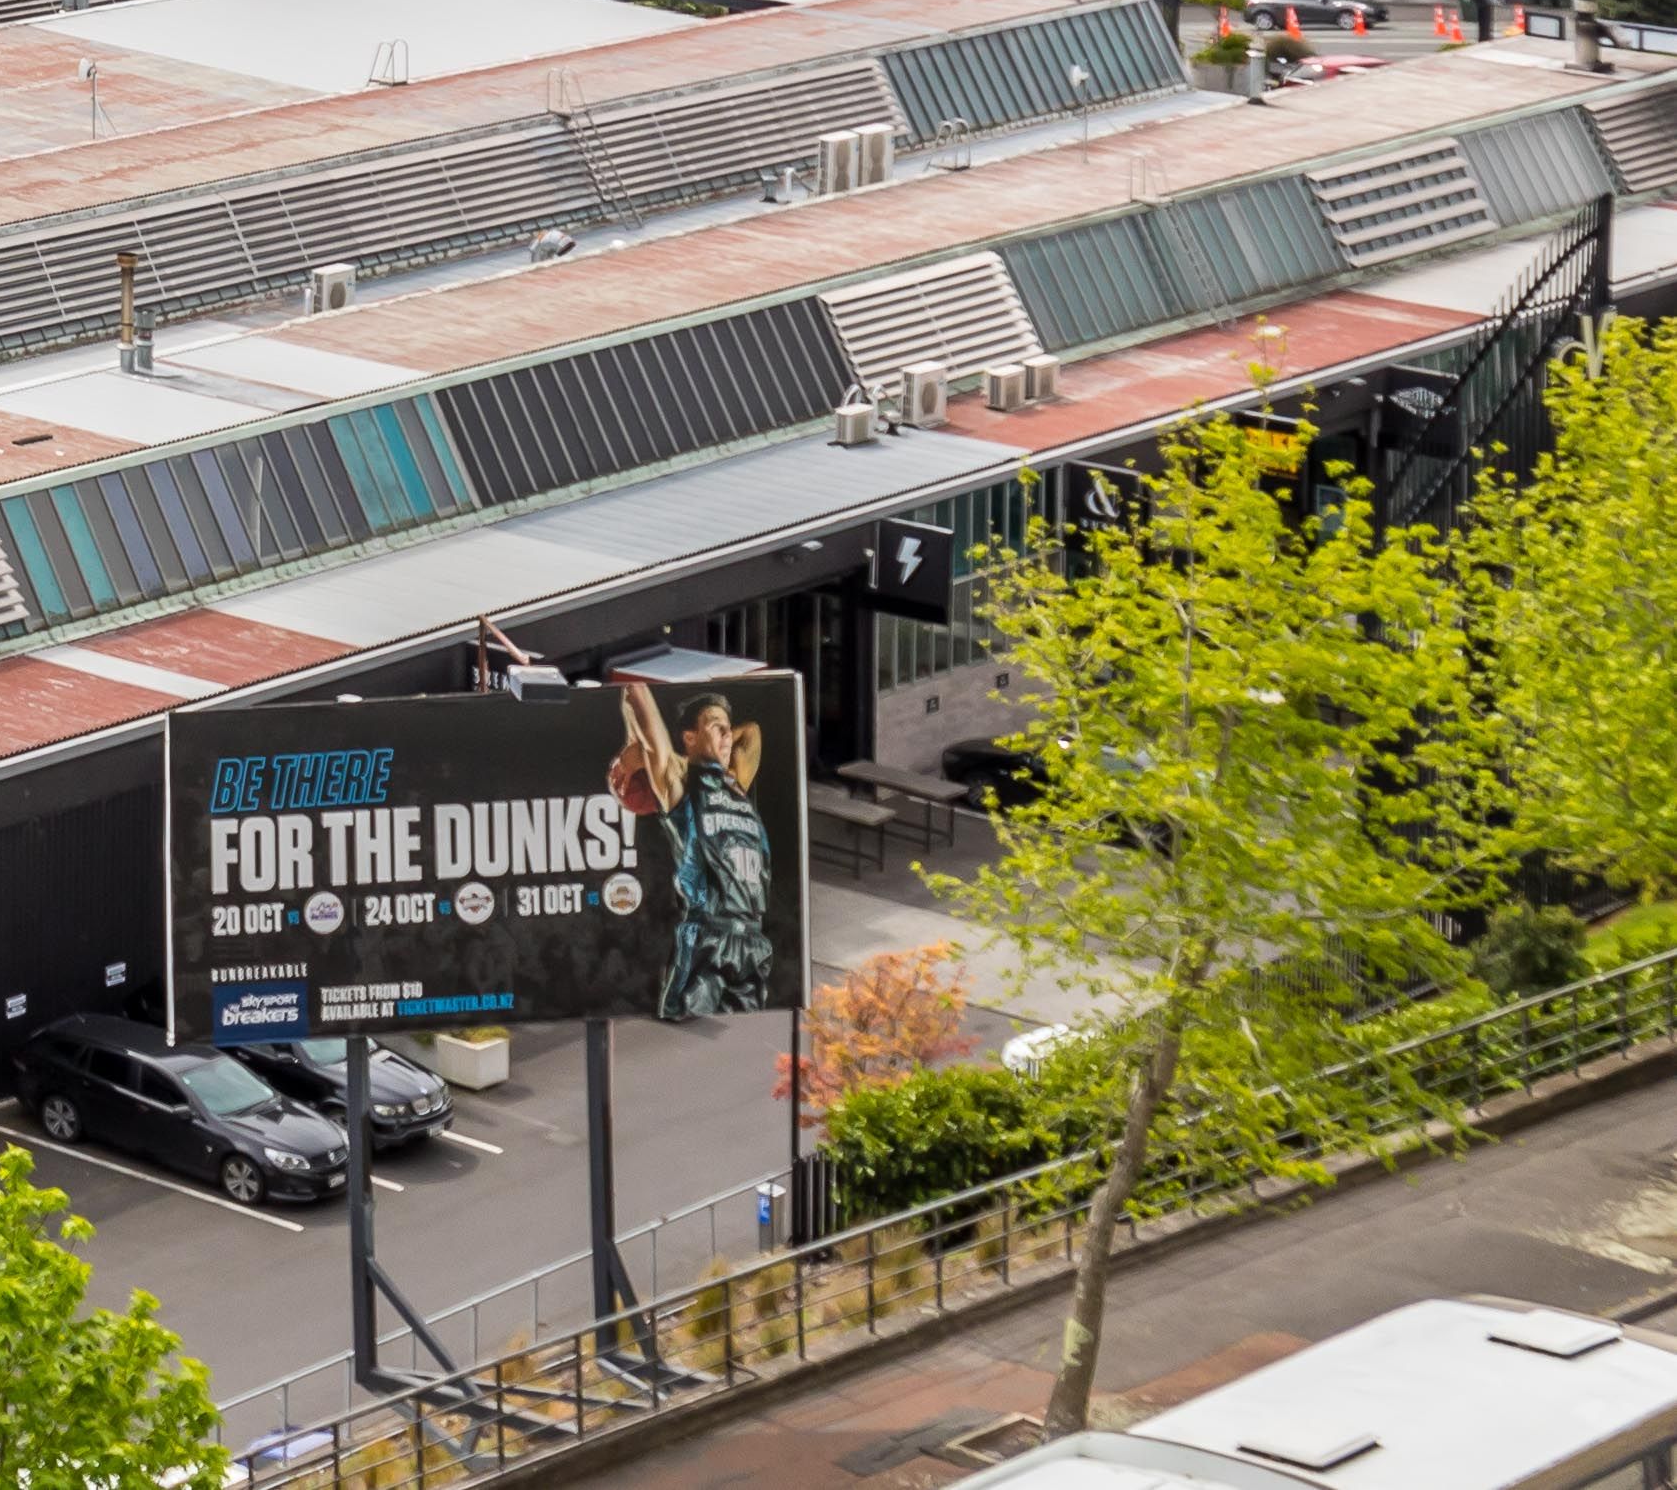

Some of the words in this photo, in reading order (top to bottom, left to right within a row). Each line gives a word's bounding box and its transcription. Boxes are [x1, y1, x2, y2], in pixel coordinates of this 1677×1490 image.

[210, 756, 266, 814] BE
[271, 748, 395, 810] THERE
[211, 814, 315, 895] FOR
[321, 806, 423, 887] THE
[433, 794, 638, 880] DUNKS!
[364, 895, 394, 926] 24
[397, 893, 436, 924] OCT
[516, 886, 539, 917] 31
[544, 883, 585, 914] OCT
[211, 905, 240, 937] 20
[244, 902, 285, 934] OCT
[320, 986, 367, 1004] TICKETS
[369, 983, 401, 1001] FROM
[221, 1005, 300, 1027] breakers
[320, 1002, 379, 1022] AVAILABLE
[380, 1001, 395, 1018] AT
